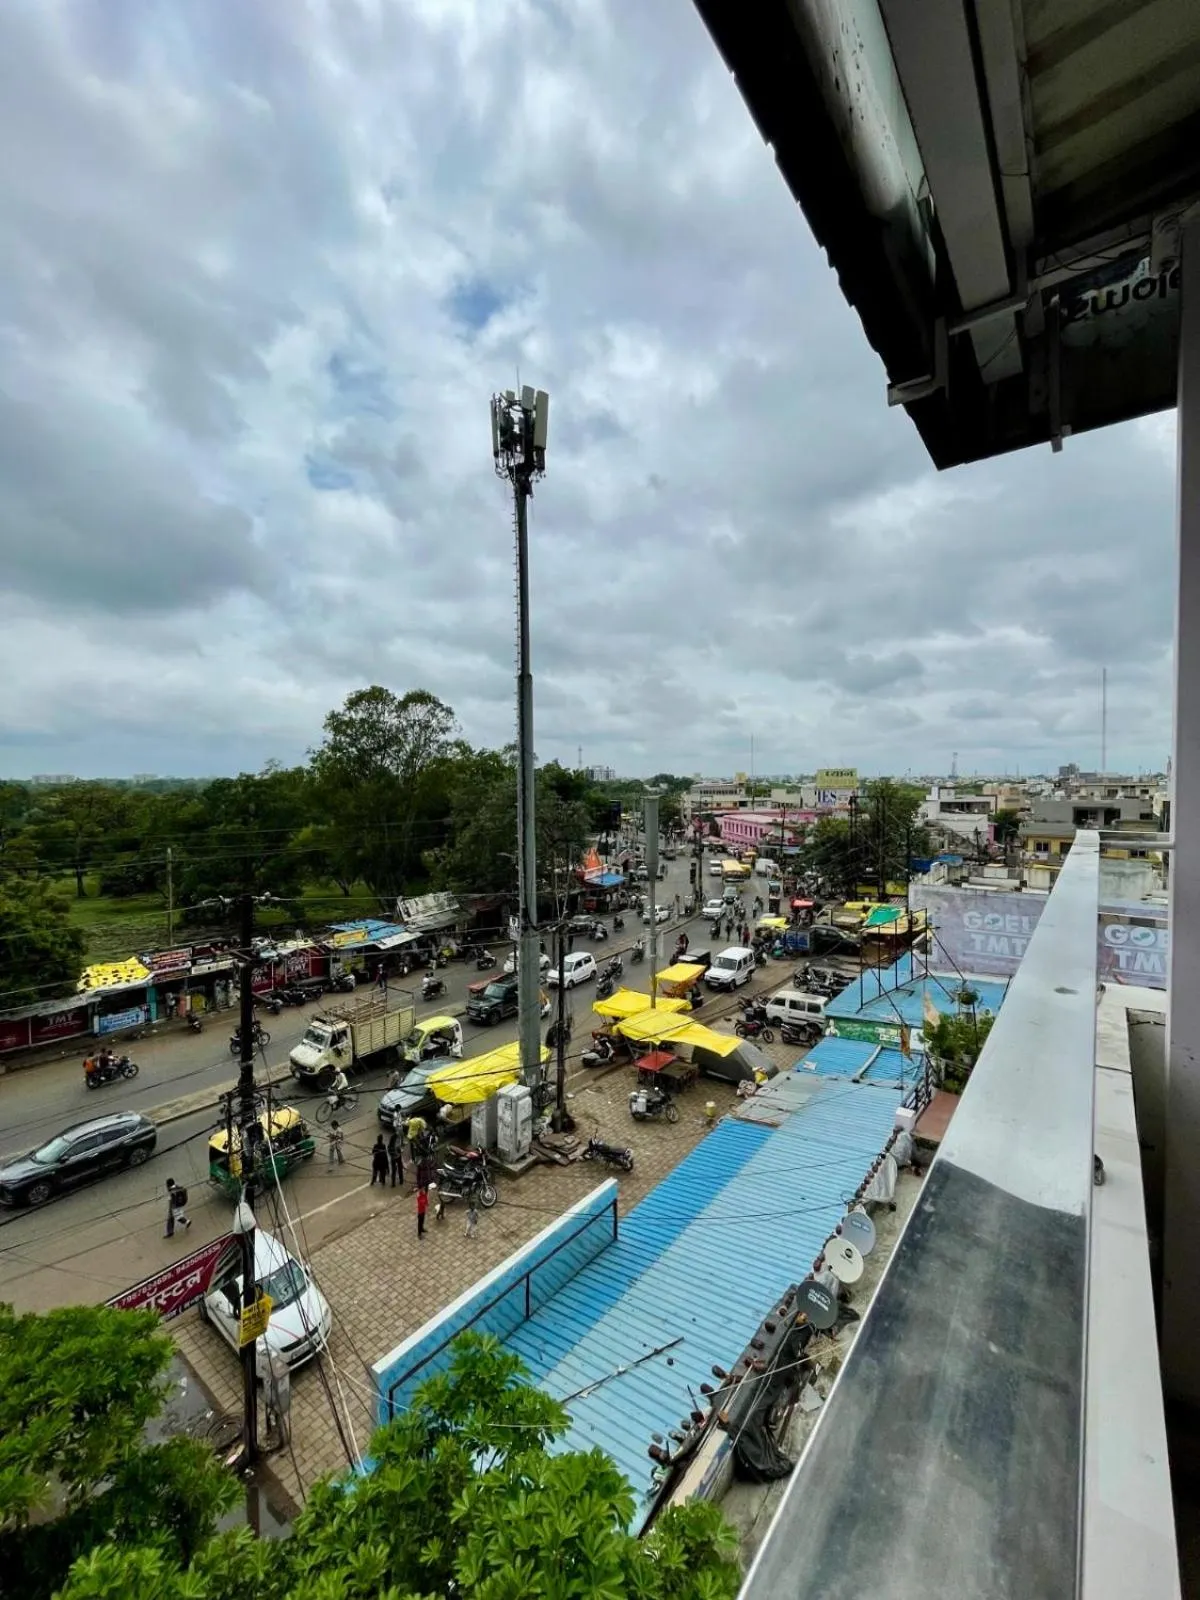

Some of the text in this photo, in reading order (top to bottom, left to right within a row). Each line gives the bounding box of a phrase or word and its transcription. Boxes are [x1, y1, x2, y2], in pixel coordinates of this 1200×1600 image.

[970, 934, 1027, 955] TMT
[1104, 924, 1168, 947] GOE
[1114, 949, 1165, 972] TM
